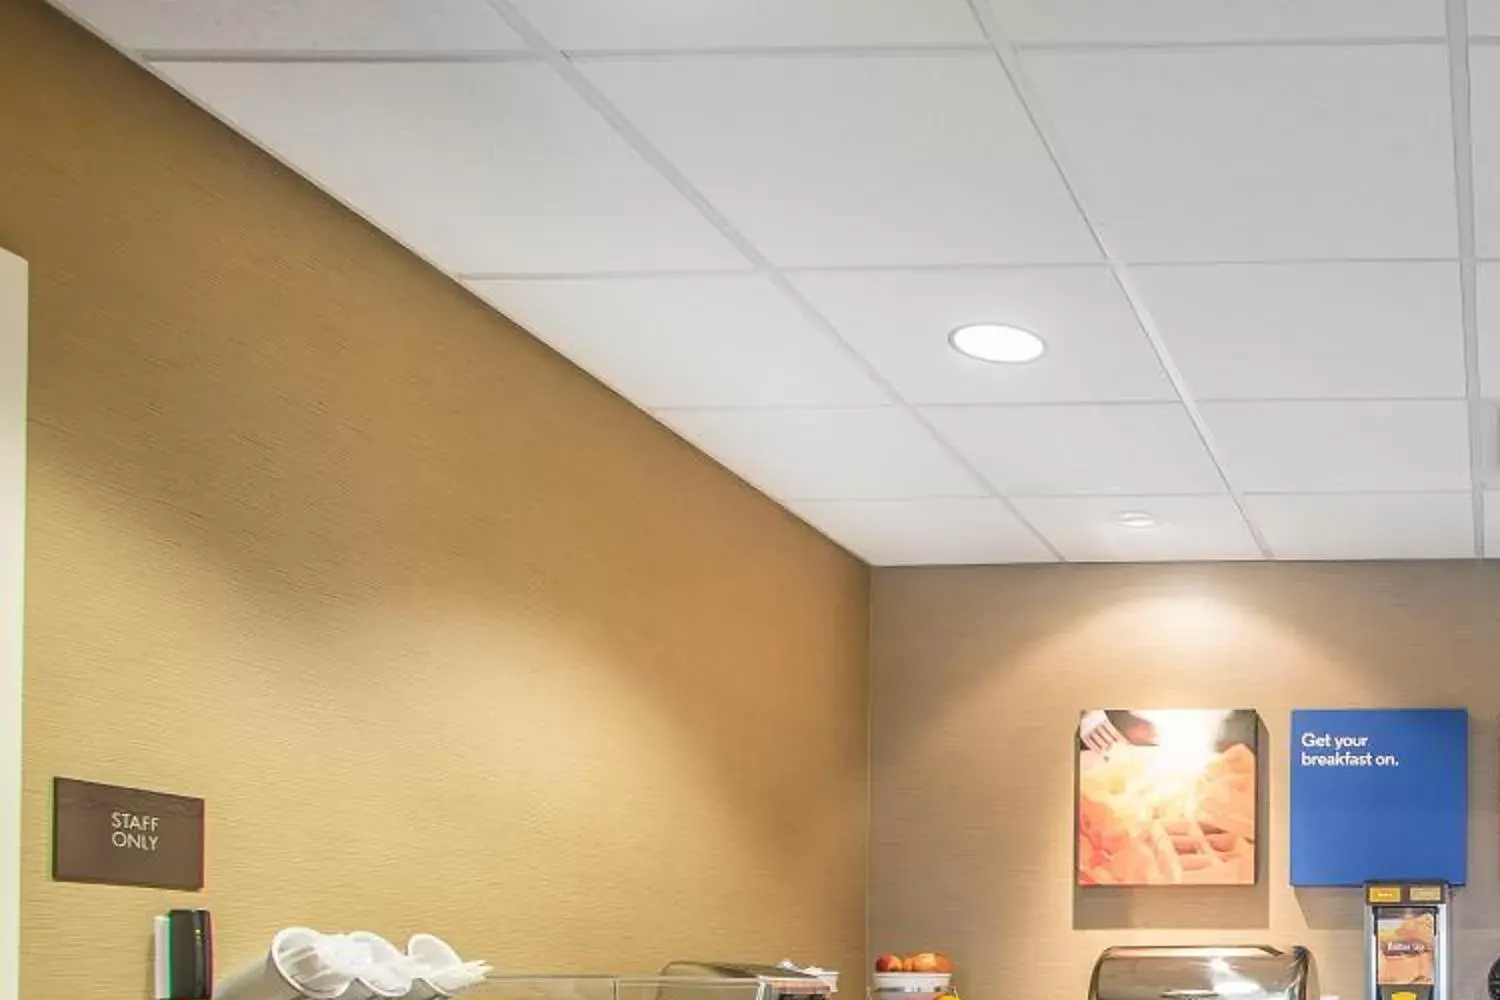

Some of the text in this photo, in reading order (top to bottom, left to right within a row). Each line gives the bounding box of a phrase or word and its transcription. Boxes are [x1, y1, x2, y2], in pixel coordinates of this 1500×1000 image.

[1301, 732, 1369, 751] Get your
[1301, 751, 1399, 767] breakfast on.
[111, 811, 160, 832] STAFF
[111, 831, 159, 851] ONLY
